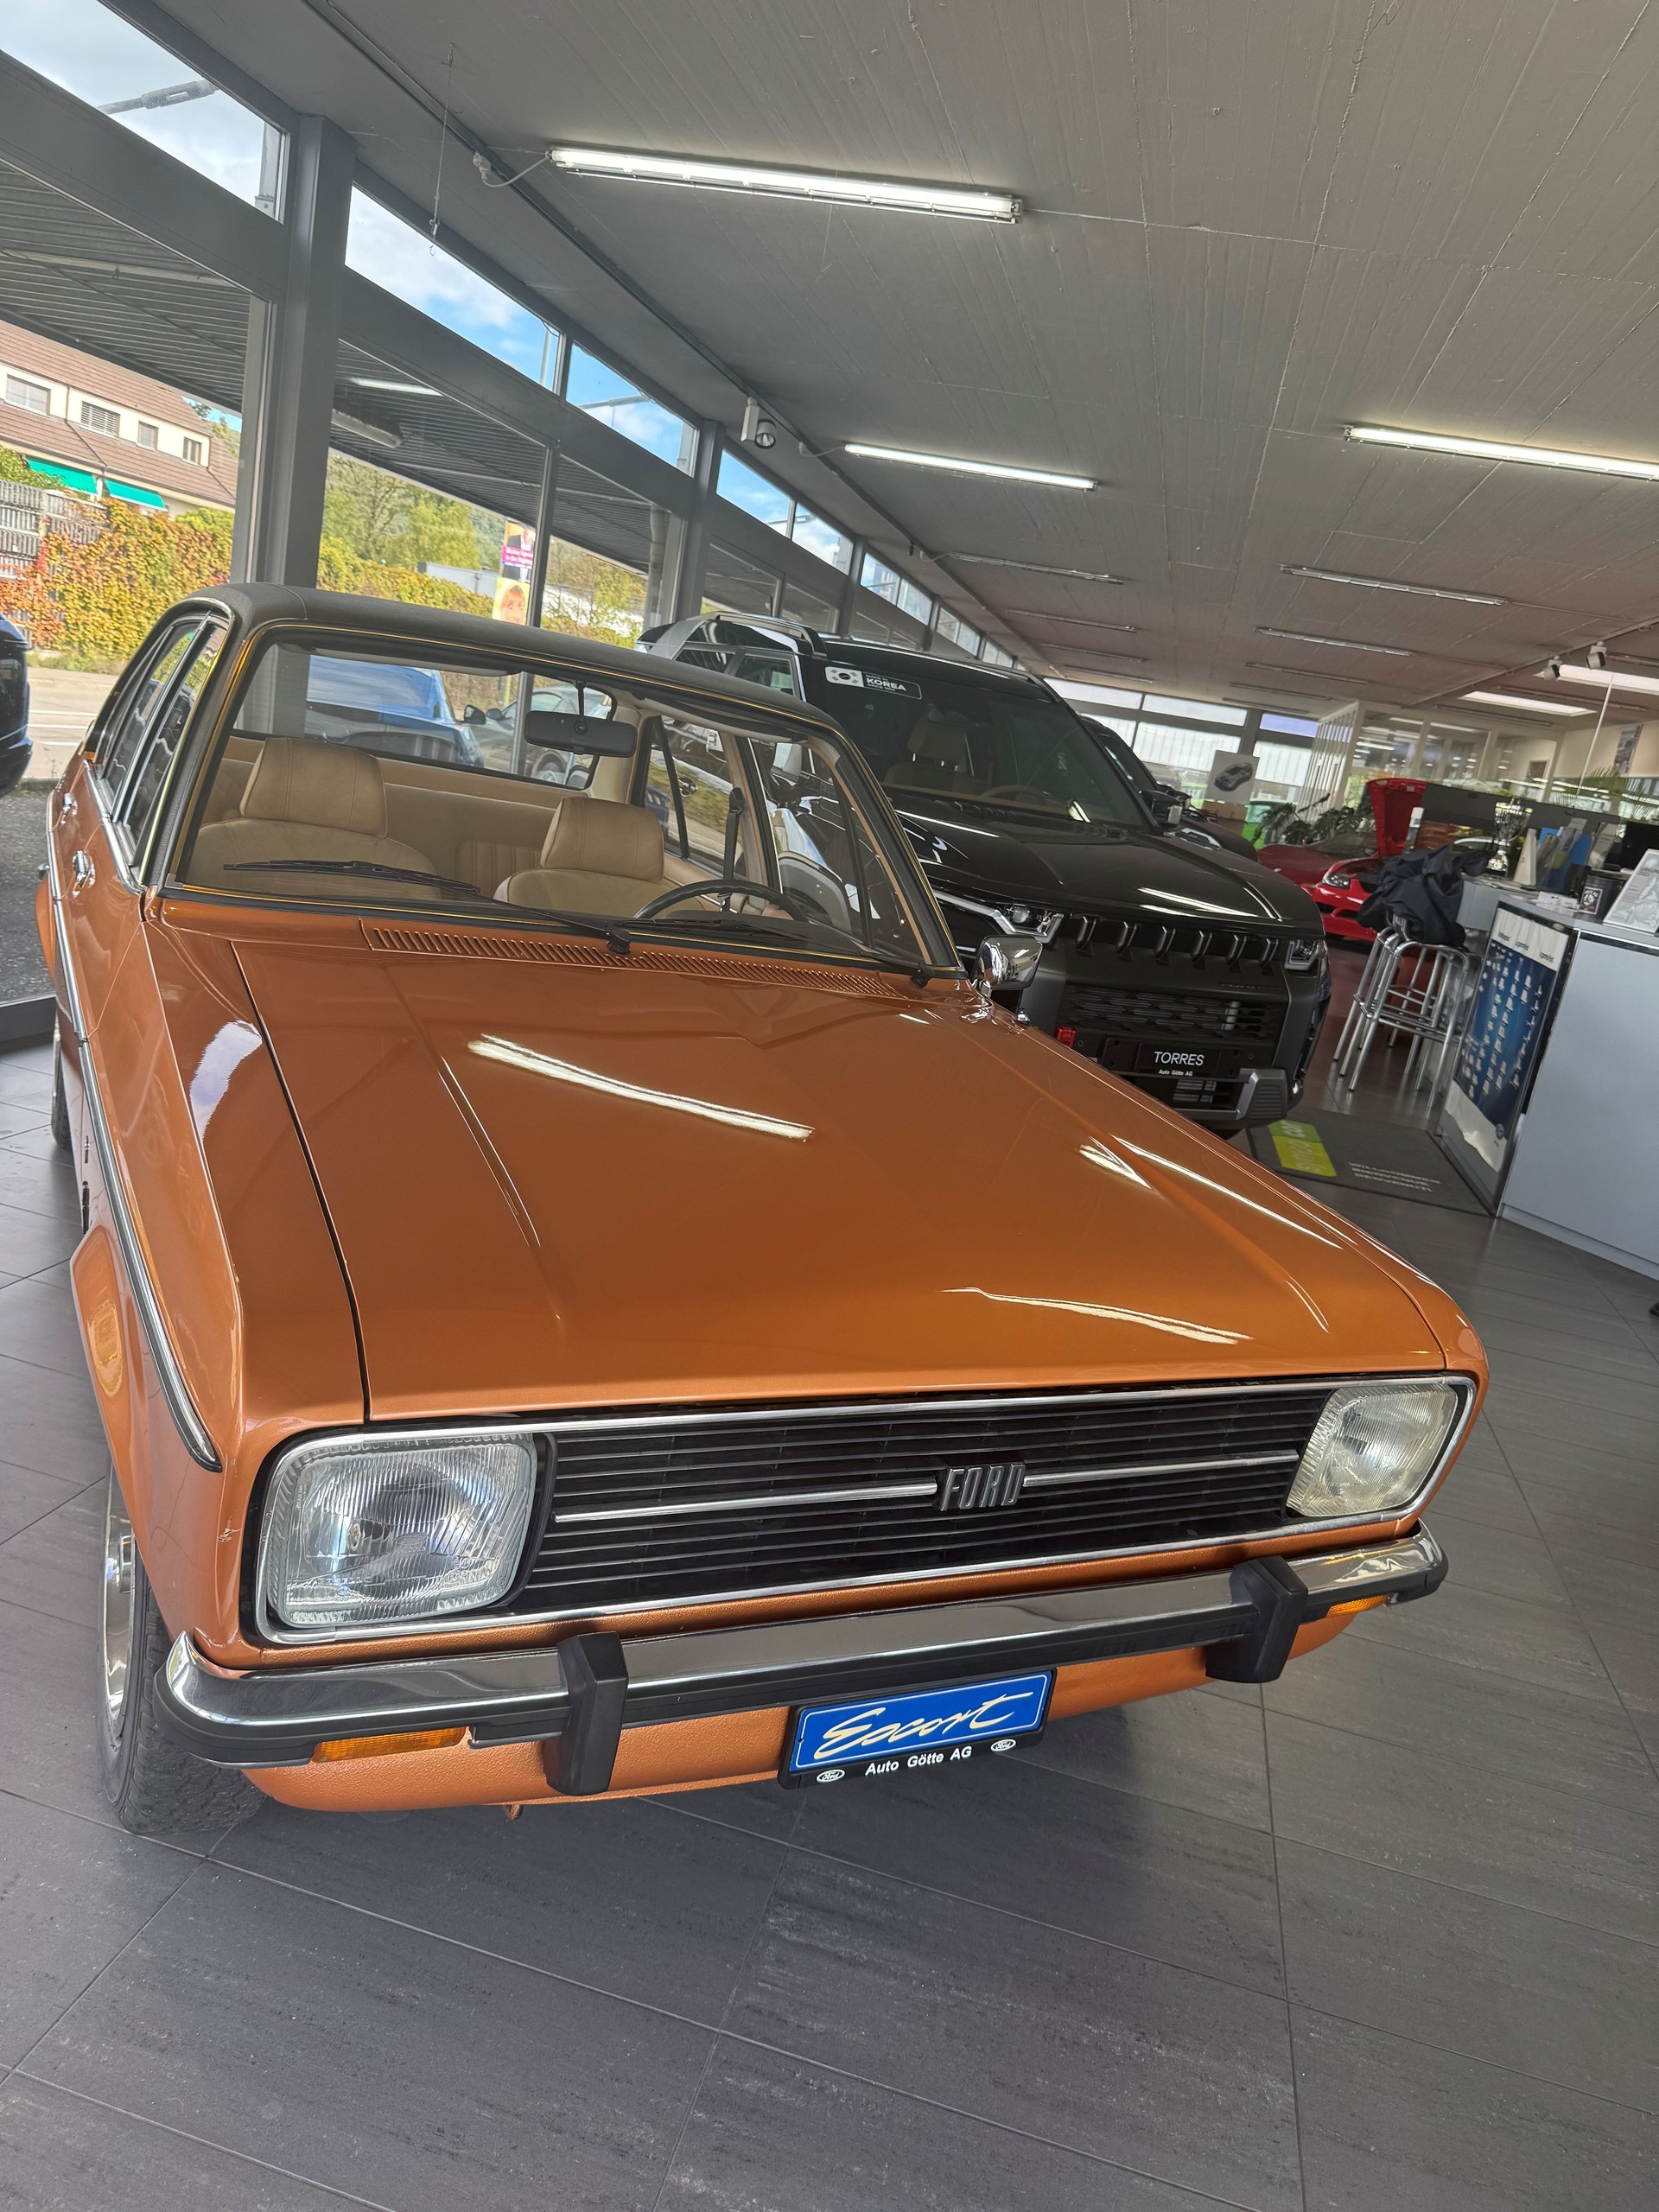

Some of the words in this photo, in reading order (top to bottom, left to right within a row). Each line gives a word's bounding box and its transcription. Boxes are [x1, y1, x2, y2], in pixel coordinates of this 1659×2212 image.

[866, 677, 906, 691] KOREA
[1154, 1051, 1205, 1066] TORRES
[939, 1463, 1027, 1511] FORD
[813, 1691, 1033, 1760] Escort
[819, 1770, 842, 1781] Ford
[865, 1760, 899, 1777] Auto
[907, 1752, 944, 1768] Götte
[950, 1745, 973, 1761] AG
[993, 1740, 1014, 1751] Ford
